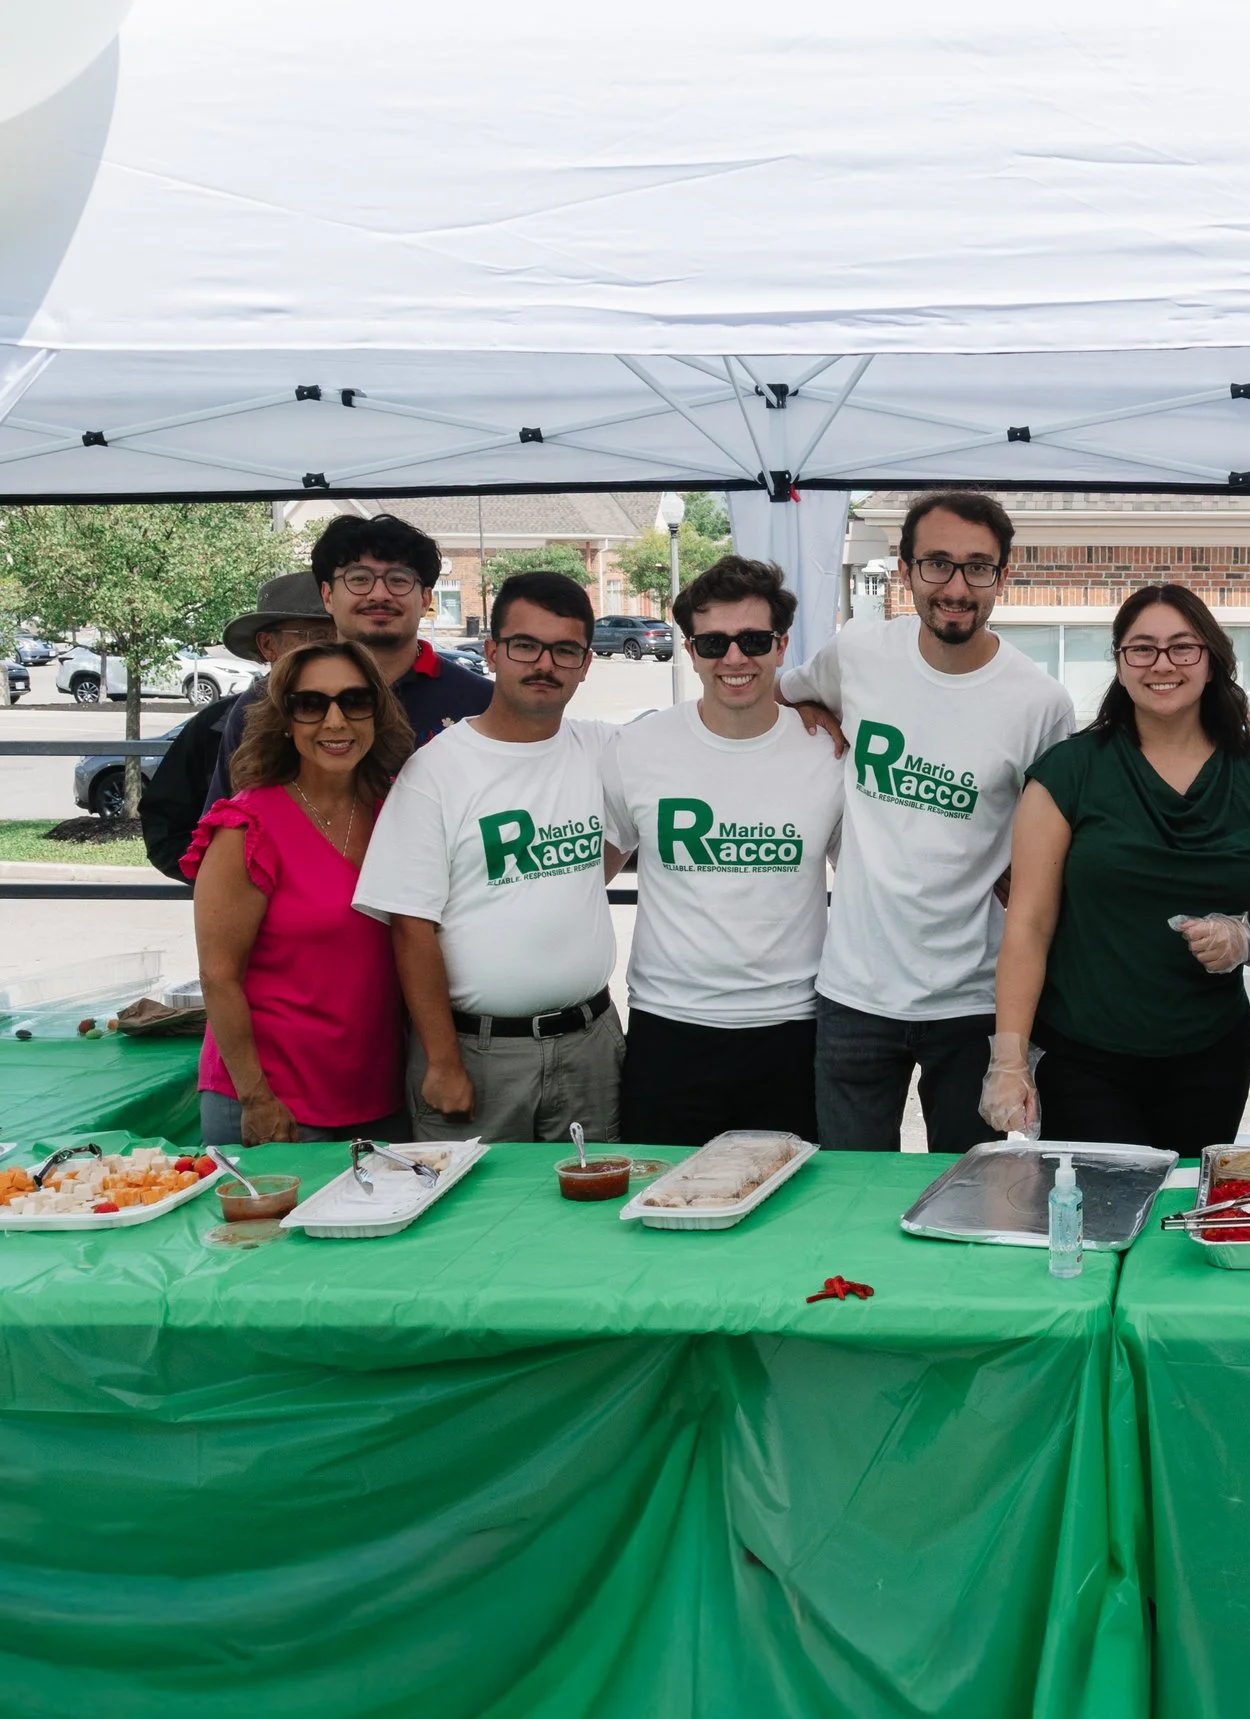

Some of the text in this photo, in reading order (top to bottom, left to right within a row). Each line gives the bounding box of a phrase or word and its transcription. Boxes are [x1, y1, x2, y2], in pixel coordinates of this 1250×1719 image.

[854, 719, 971, 808] Racco
[904, 754, 978, 790] Mario G.
[878, 793, 926, 811] RESPONSIBLE.
[927, 806, 972, 820] RESPONSIVE.
[538, 815, 603, 841] Mario G.
[657, 798, 798, 865] Racco
[719, 822, 801, 838] Mario G.
[478, 809, 601, 880] Racco
[524, 867, 573, 880] RESPONSIBLE.
[662, 863, 800, 874] RELIABLE. RESPONSIBLE. RESPONSIVE.
